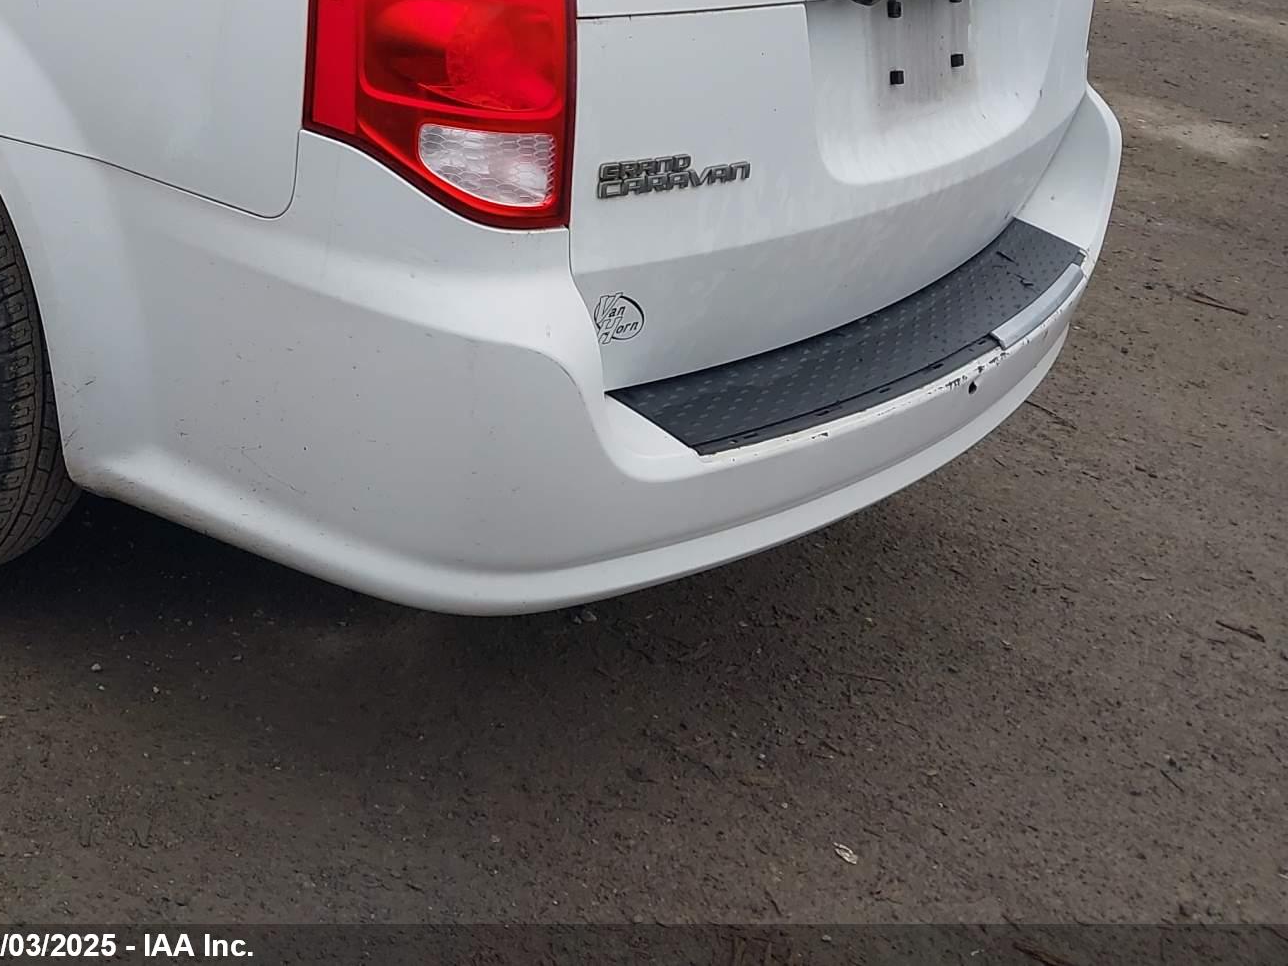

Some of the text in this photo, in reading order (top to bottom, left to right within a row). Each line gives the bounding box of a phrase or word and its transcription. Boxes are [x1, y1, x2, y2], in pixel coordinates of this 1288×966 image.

[597, 162, 750, 199] CARAVAN
[599, 155, 691, 179] GRAND
[597, 292, 626, 322] Van
[598, 316, 639, 344] Horn
